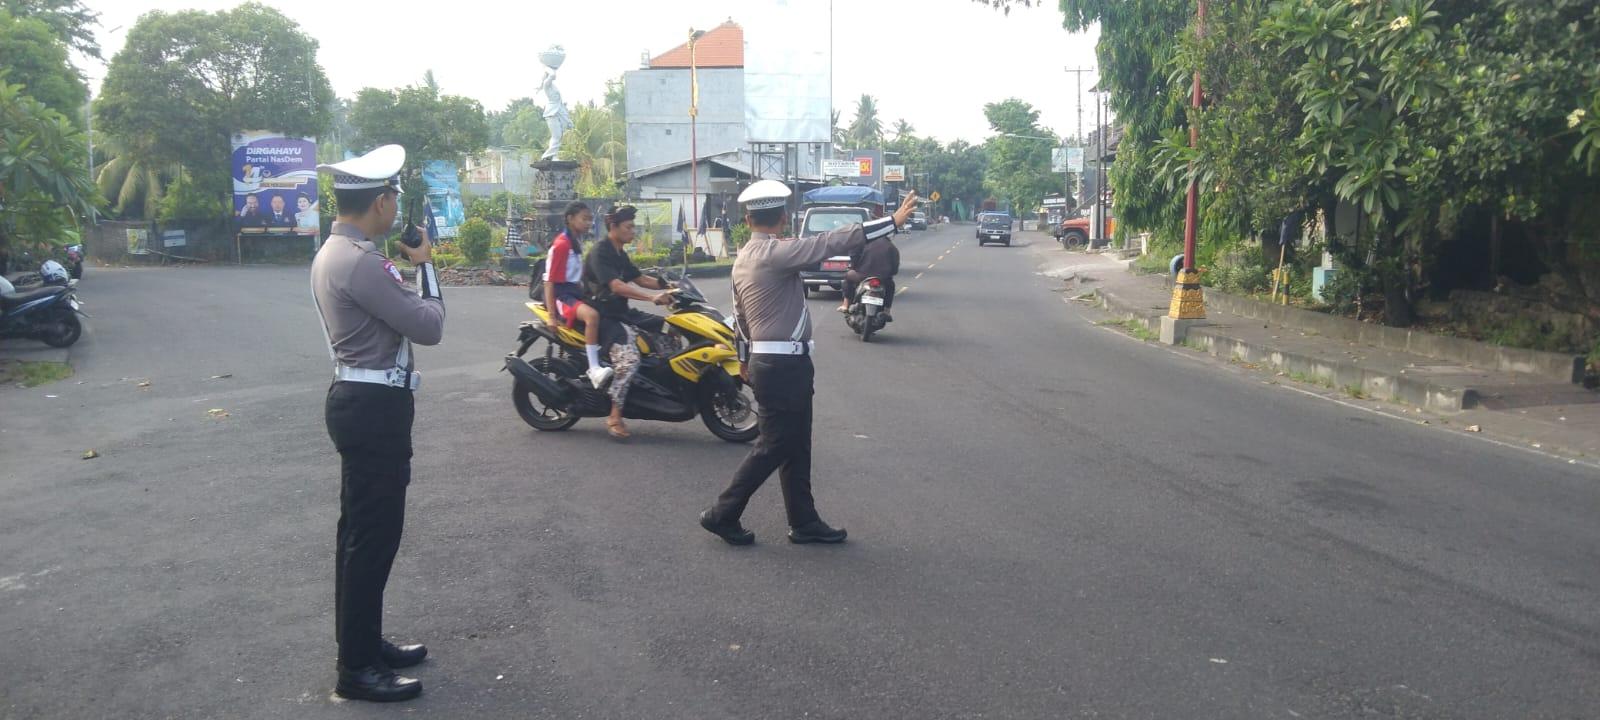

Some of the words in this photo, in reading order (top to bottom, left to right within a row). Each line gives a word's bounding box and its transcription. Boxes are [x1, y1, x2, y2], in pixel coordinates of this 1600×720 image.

[246, 147, 301, 155] DIRGAHAYU
[246, 155, 269, 163] Partai
[270, 155, 303, 163] NasDem
